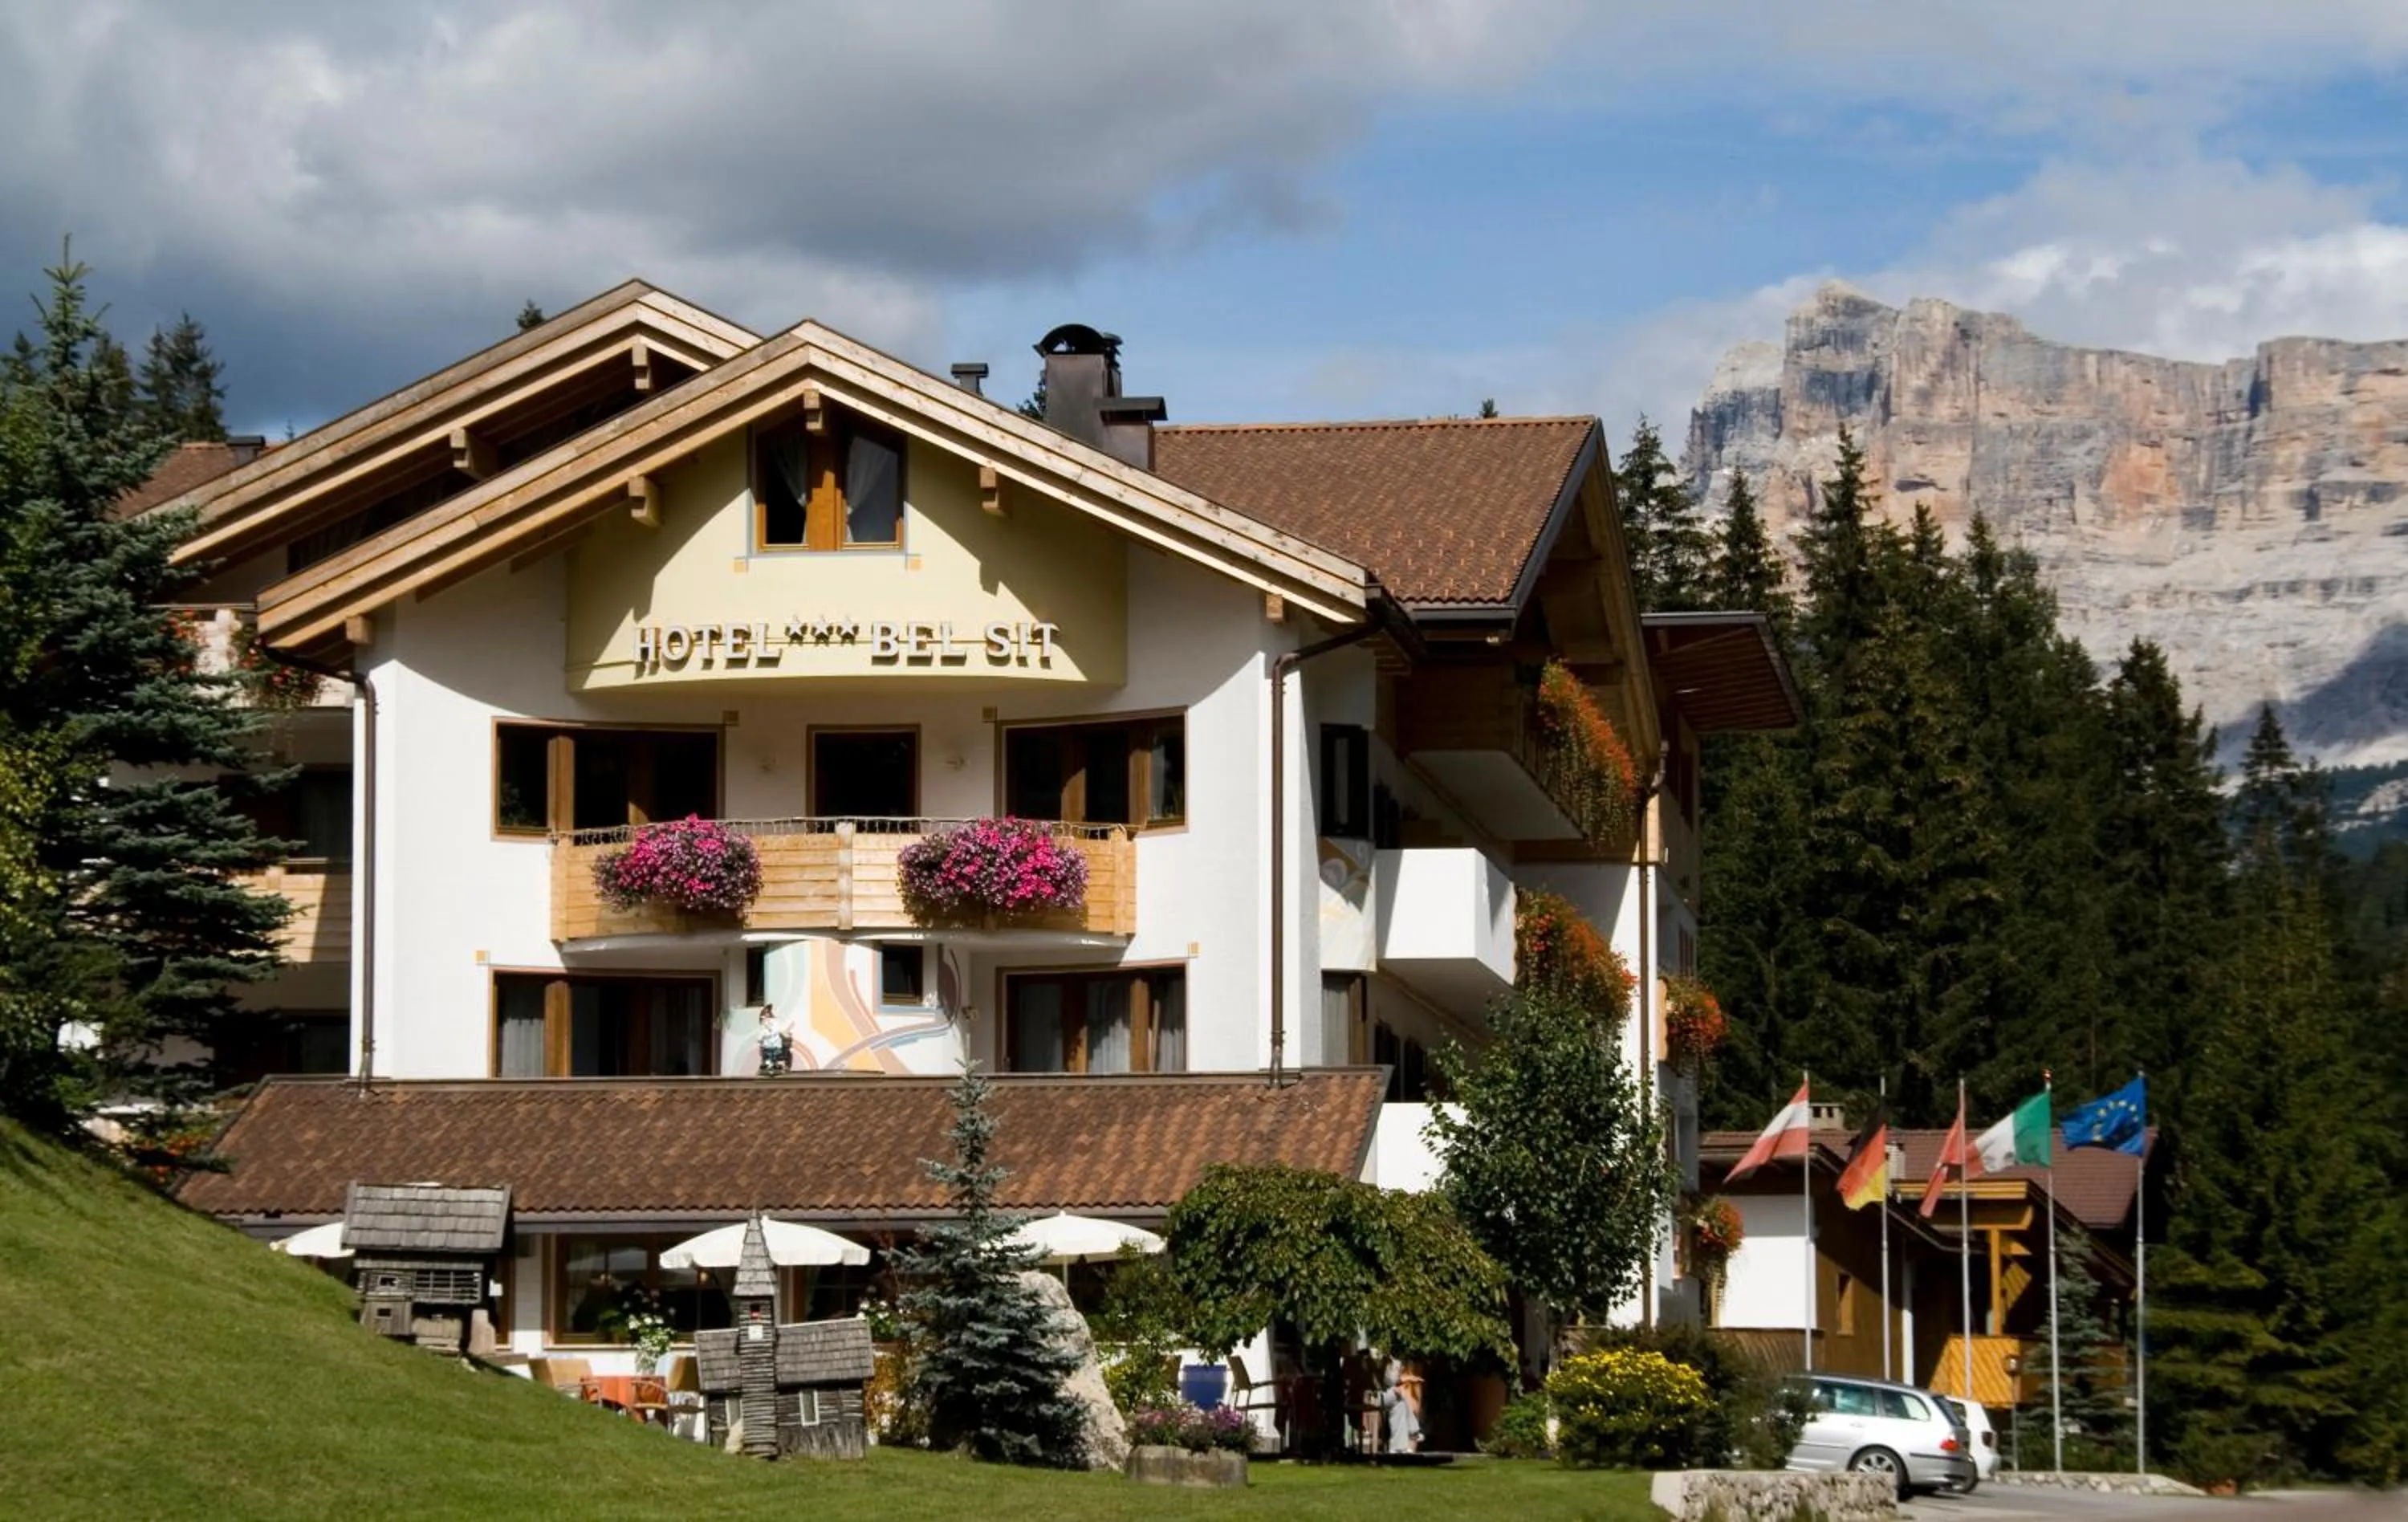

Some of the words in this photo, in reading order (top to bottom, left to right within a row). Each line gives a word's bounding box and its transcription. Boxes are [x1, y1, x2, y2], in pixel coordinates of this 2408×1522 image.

[633, 622, 783, 665] HOTEL
[871, 620, 967, 662] BEL
[984, 621, 1060, 662] SIT
